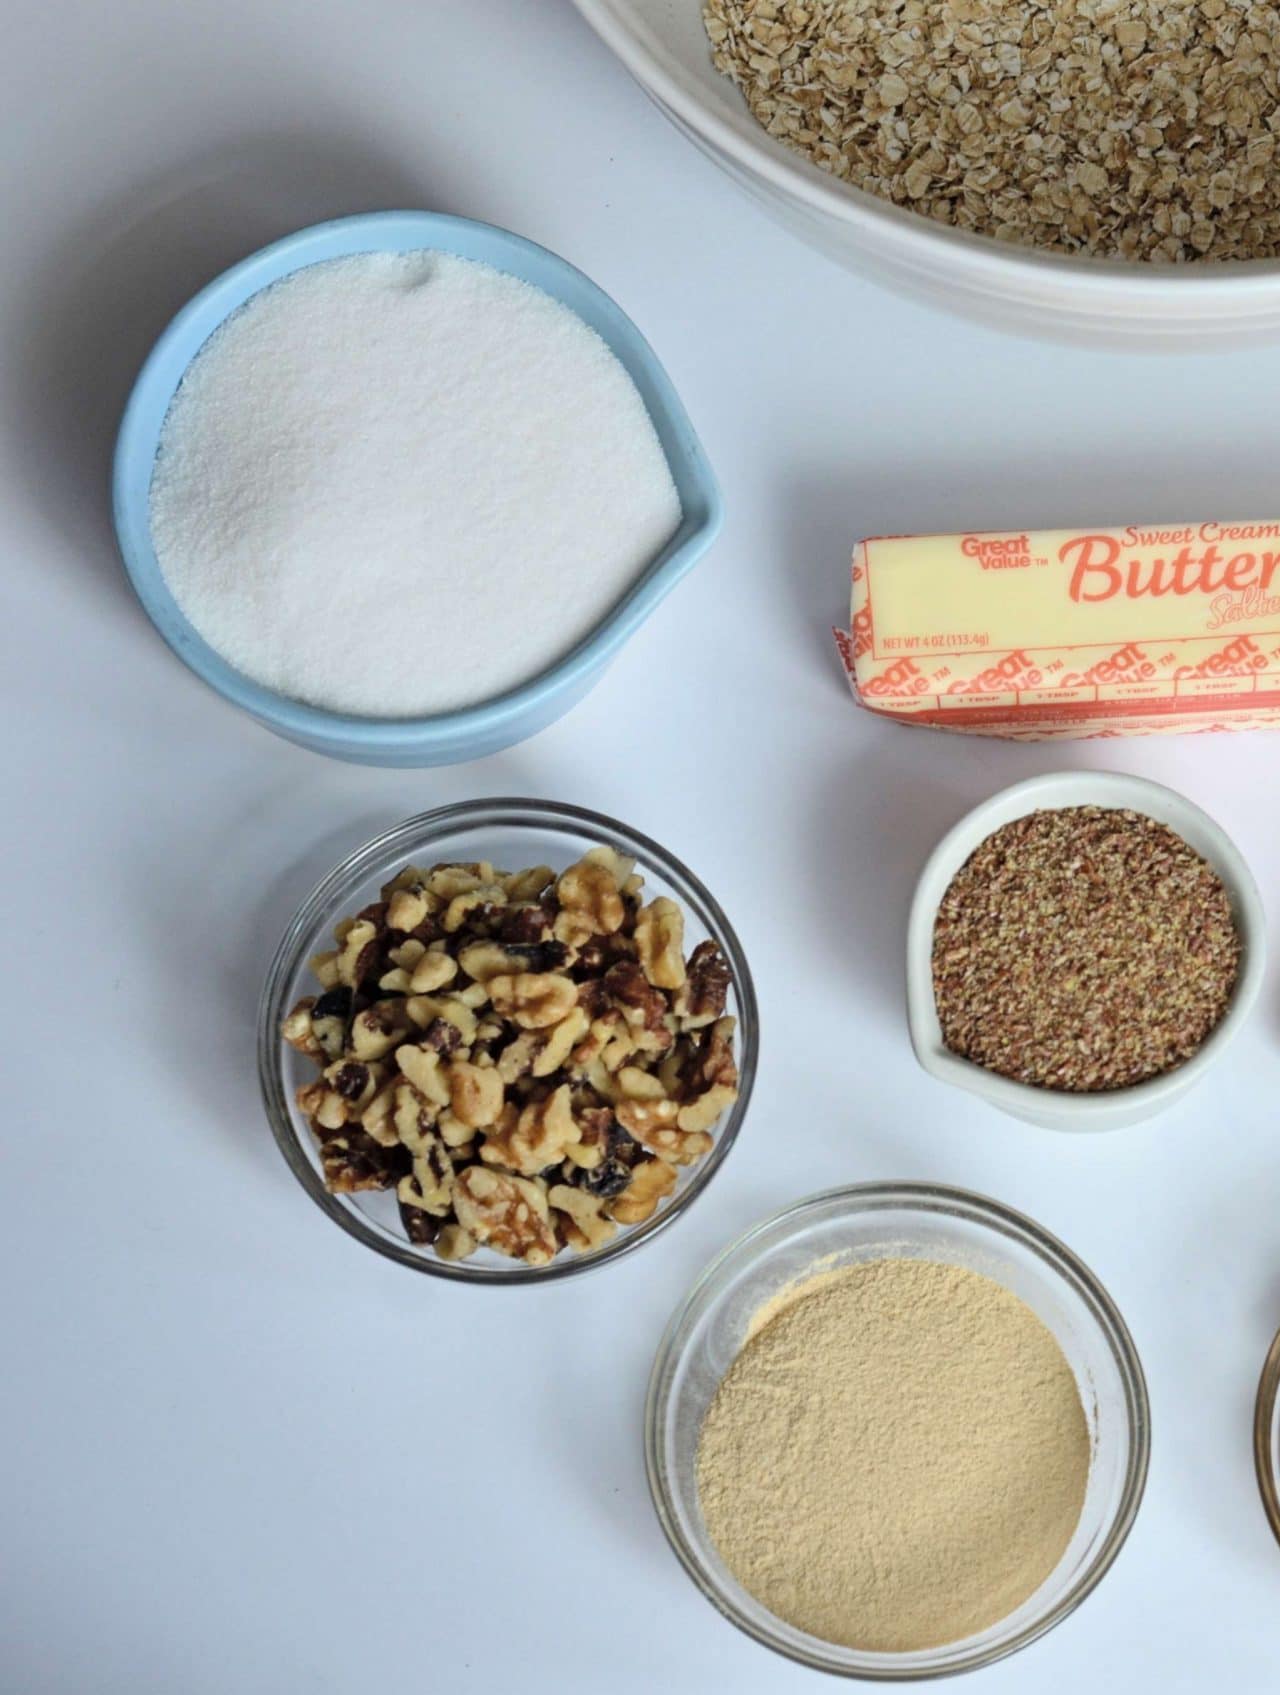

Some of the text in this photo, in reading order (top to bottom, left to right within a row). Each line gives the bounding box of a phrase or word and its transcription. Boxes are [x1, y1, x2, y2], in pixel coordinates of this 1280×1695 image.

[961, 535, 1030, 557] Great
[1121, 526, 1194, 548] Sweet
[978, 554, 1031, 570] Value
[883, 631, 990, 650] NET WT 4 OZ (113.4g)
